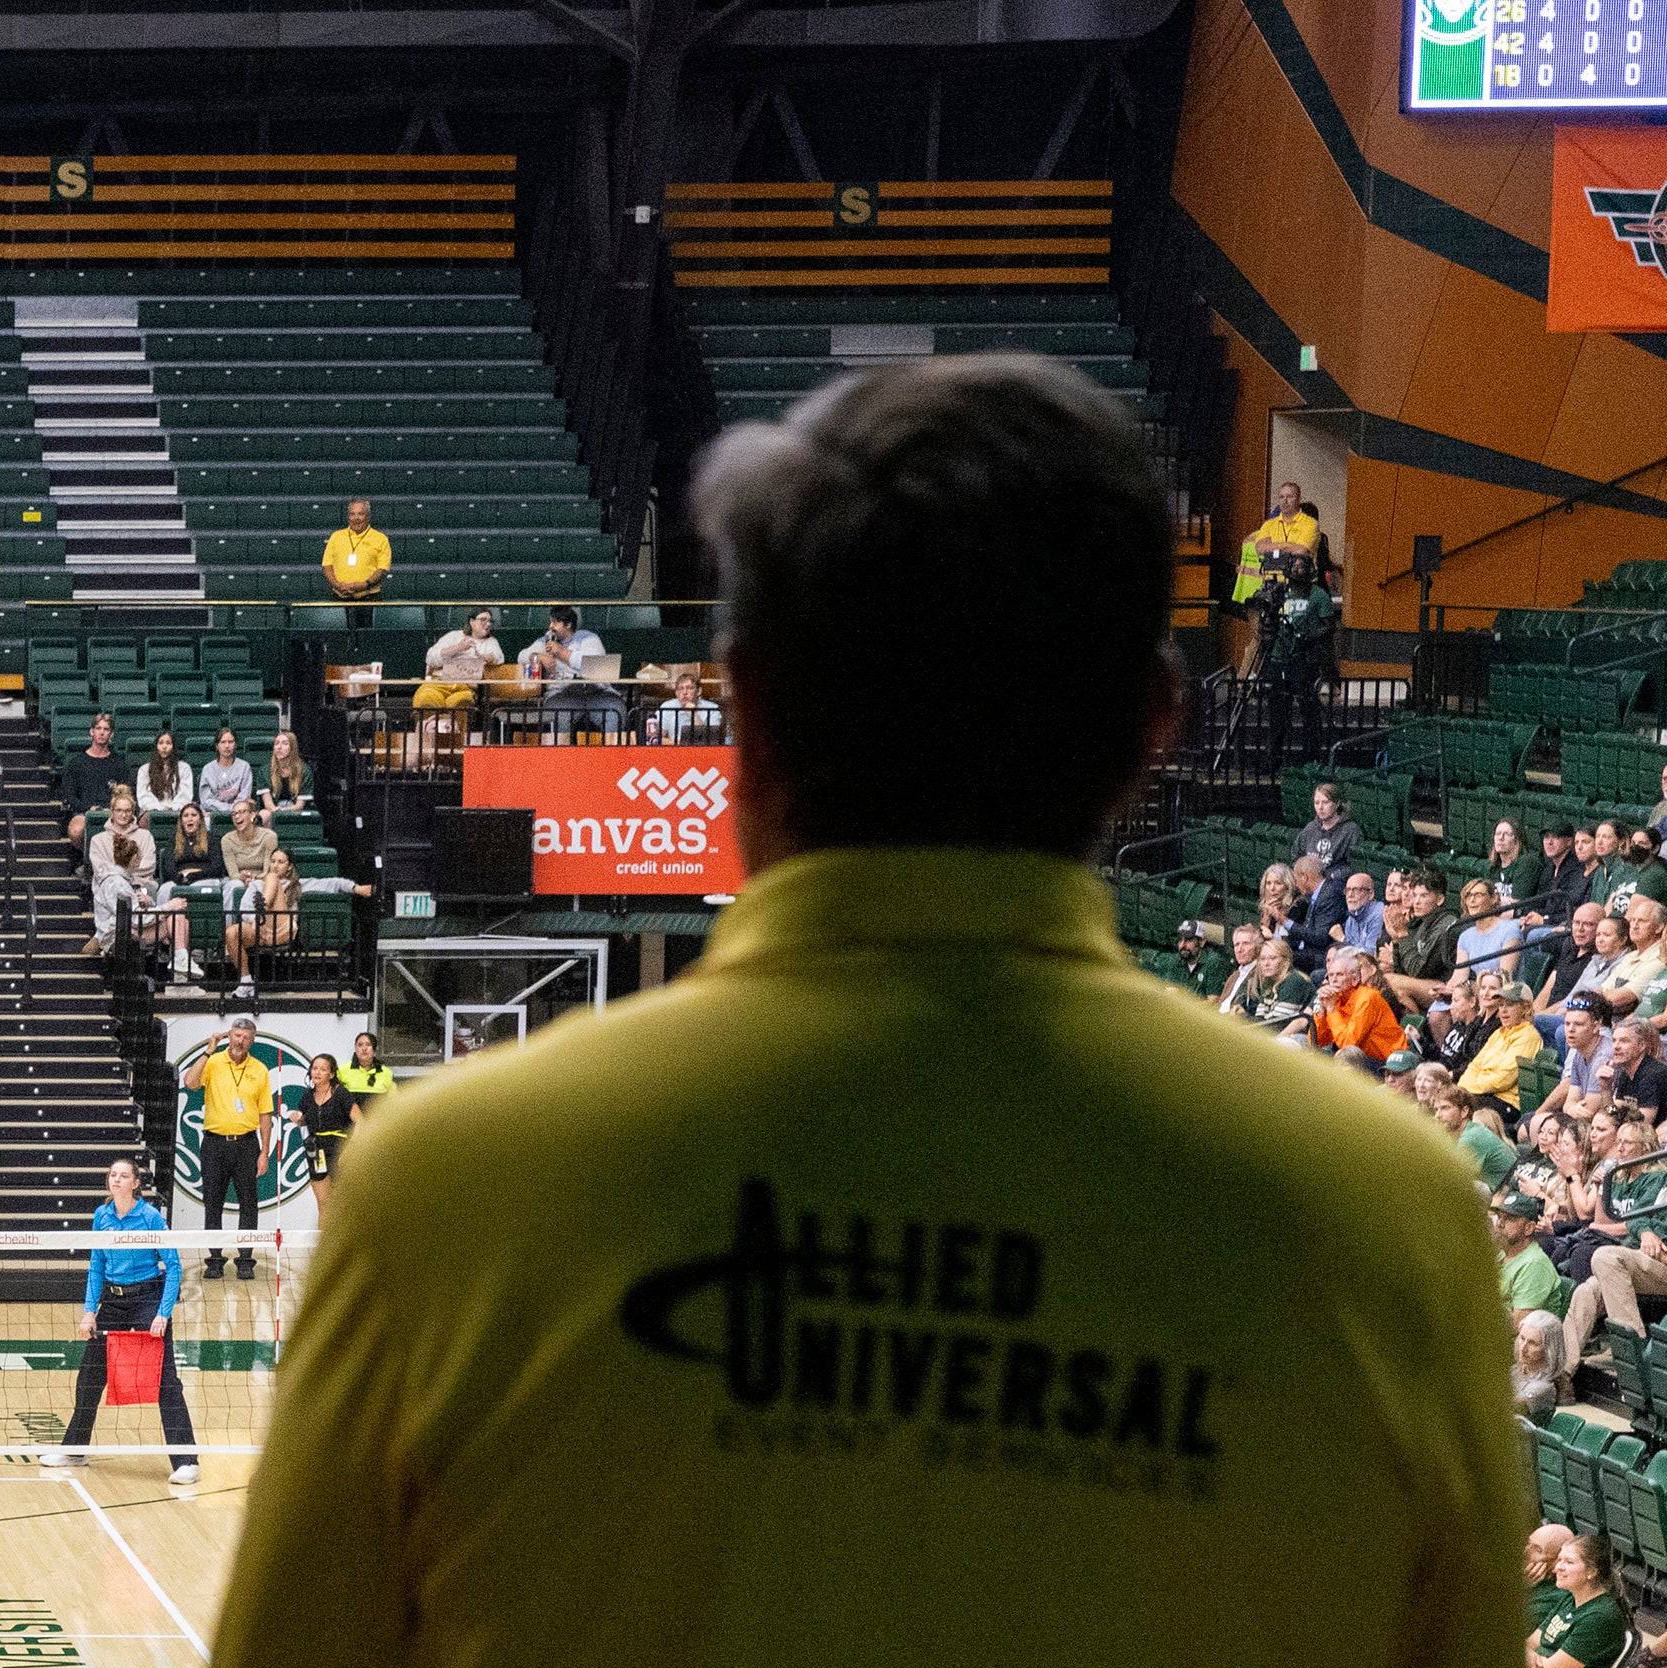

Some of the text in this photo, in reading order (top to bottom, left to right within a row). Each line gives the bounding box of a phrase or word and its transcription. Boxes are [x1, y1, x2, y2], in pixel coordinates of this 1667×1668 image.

[1493, 30, 1642, 54] 42 4 0 0
[1494, 63, 1640, 87] 18 0 4 0
[57, 160, 89, 200] S
[842, 188, 870, 224] S
[533, 817, 707, 855] anvas
[616, 860, 704, 875] credit union
[403, 894, 431, 916] EXIT
[113, 1233, 161, 1245] uchealth
[734, 1176, 1042, 1321] ALLIED
[725, 1280, 1217, 1458] UNIVERSAL
